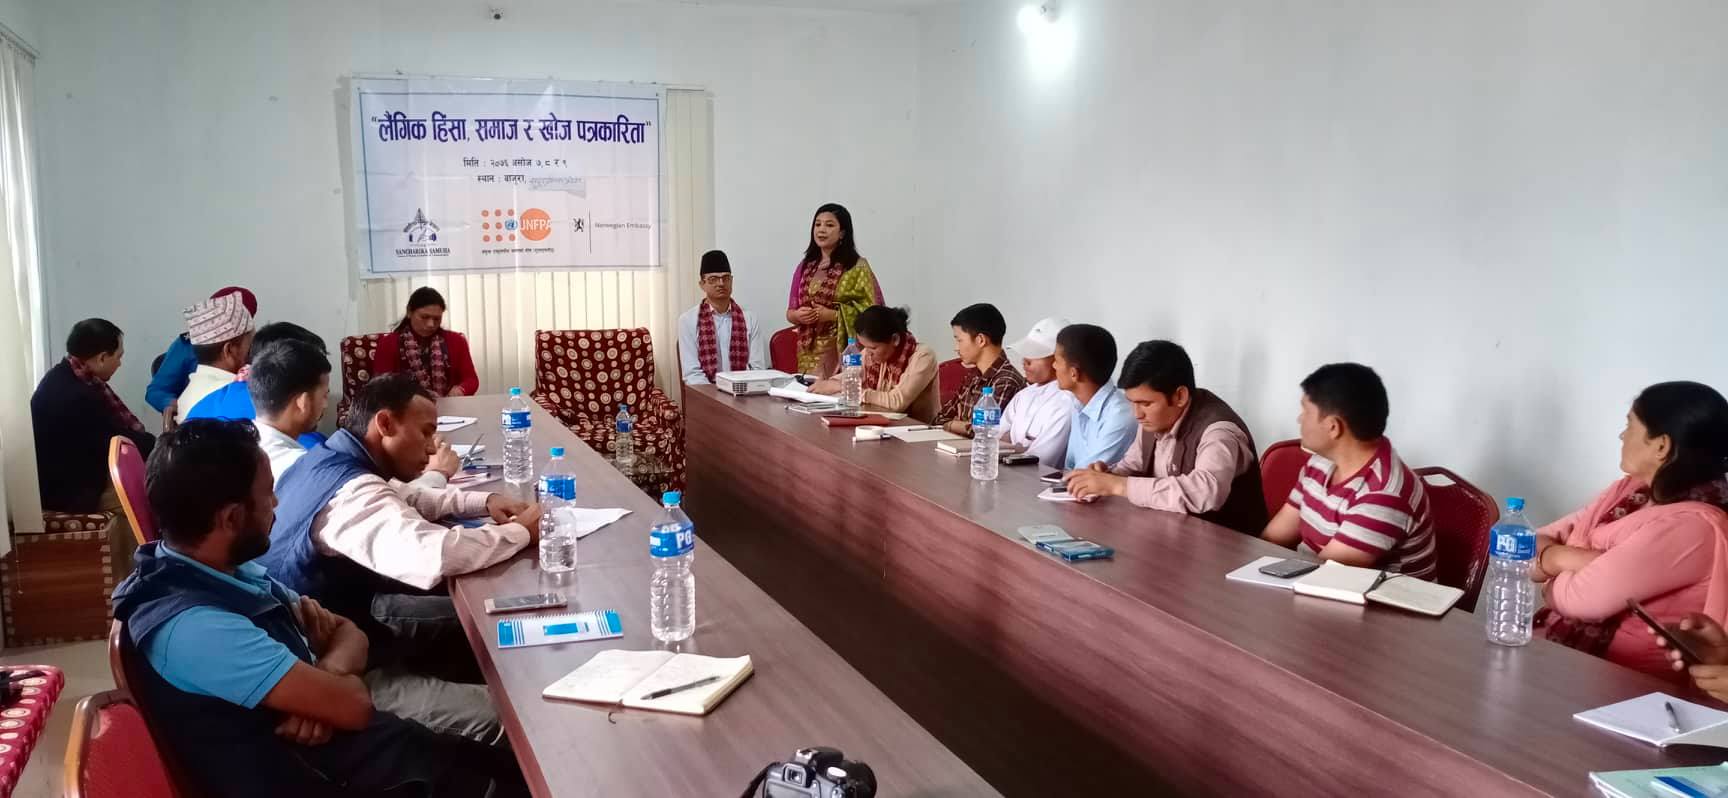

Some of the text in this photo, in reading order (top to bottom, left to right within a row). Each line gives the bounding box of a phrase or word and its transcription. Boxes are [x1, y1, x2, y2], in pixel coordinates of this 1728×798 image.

[474, 118, 519, 142] समाज
[523, 119, 534, 141] र
[539, 112, 572, 141] खोज
[463, 156, 479, 167] मिति
